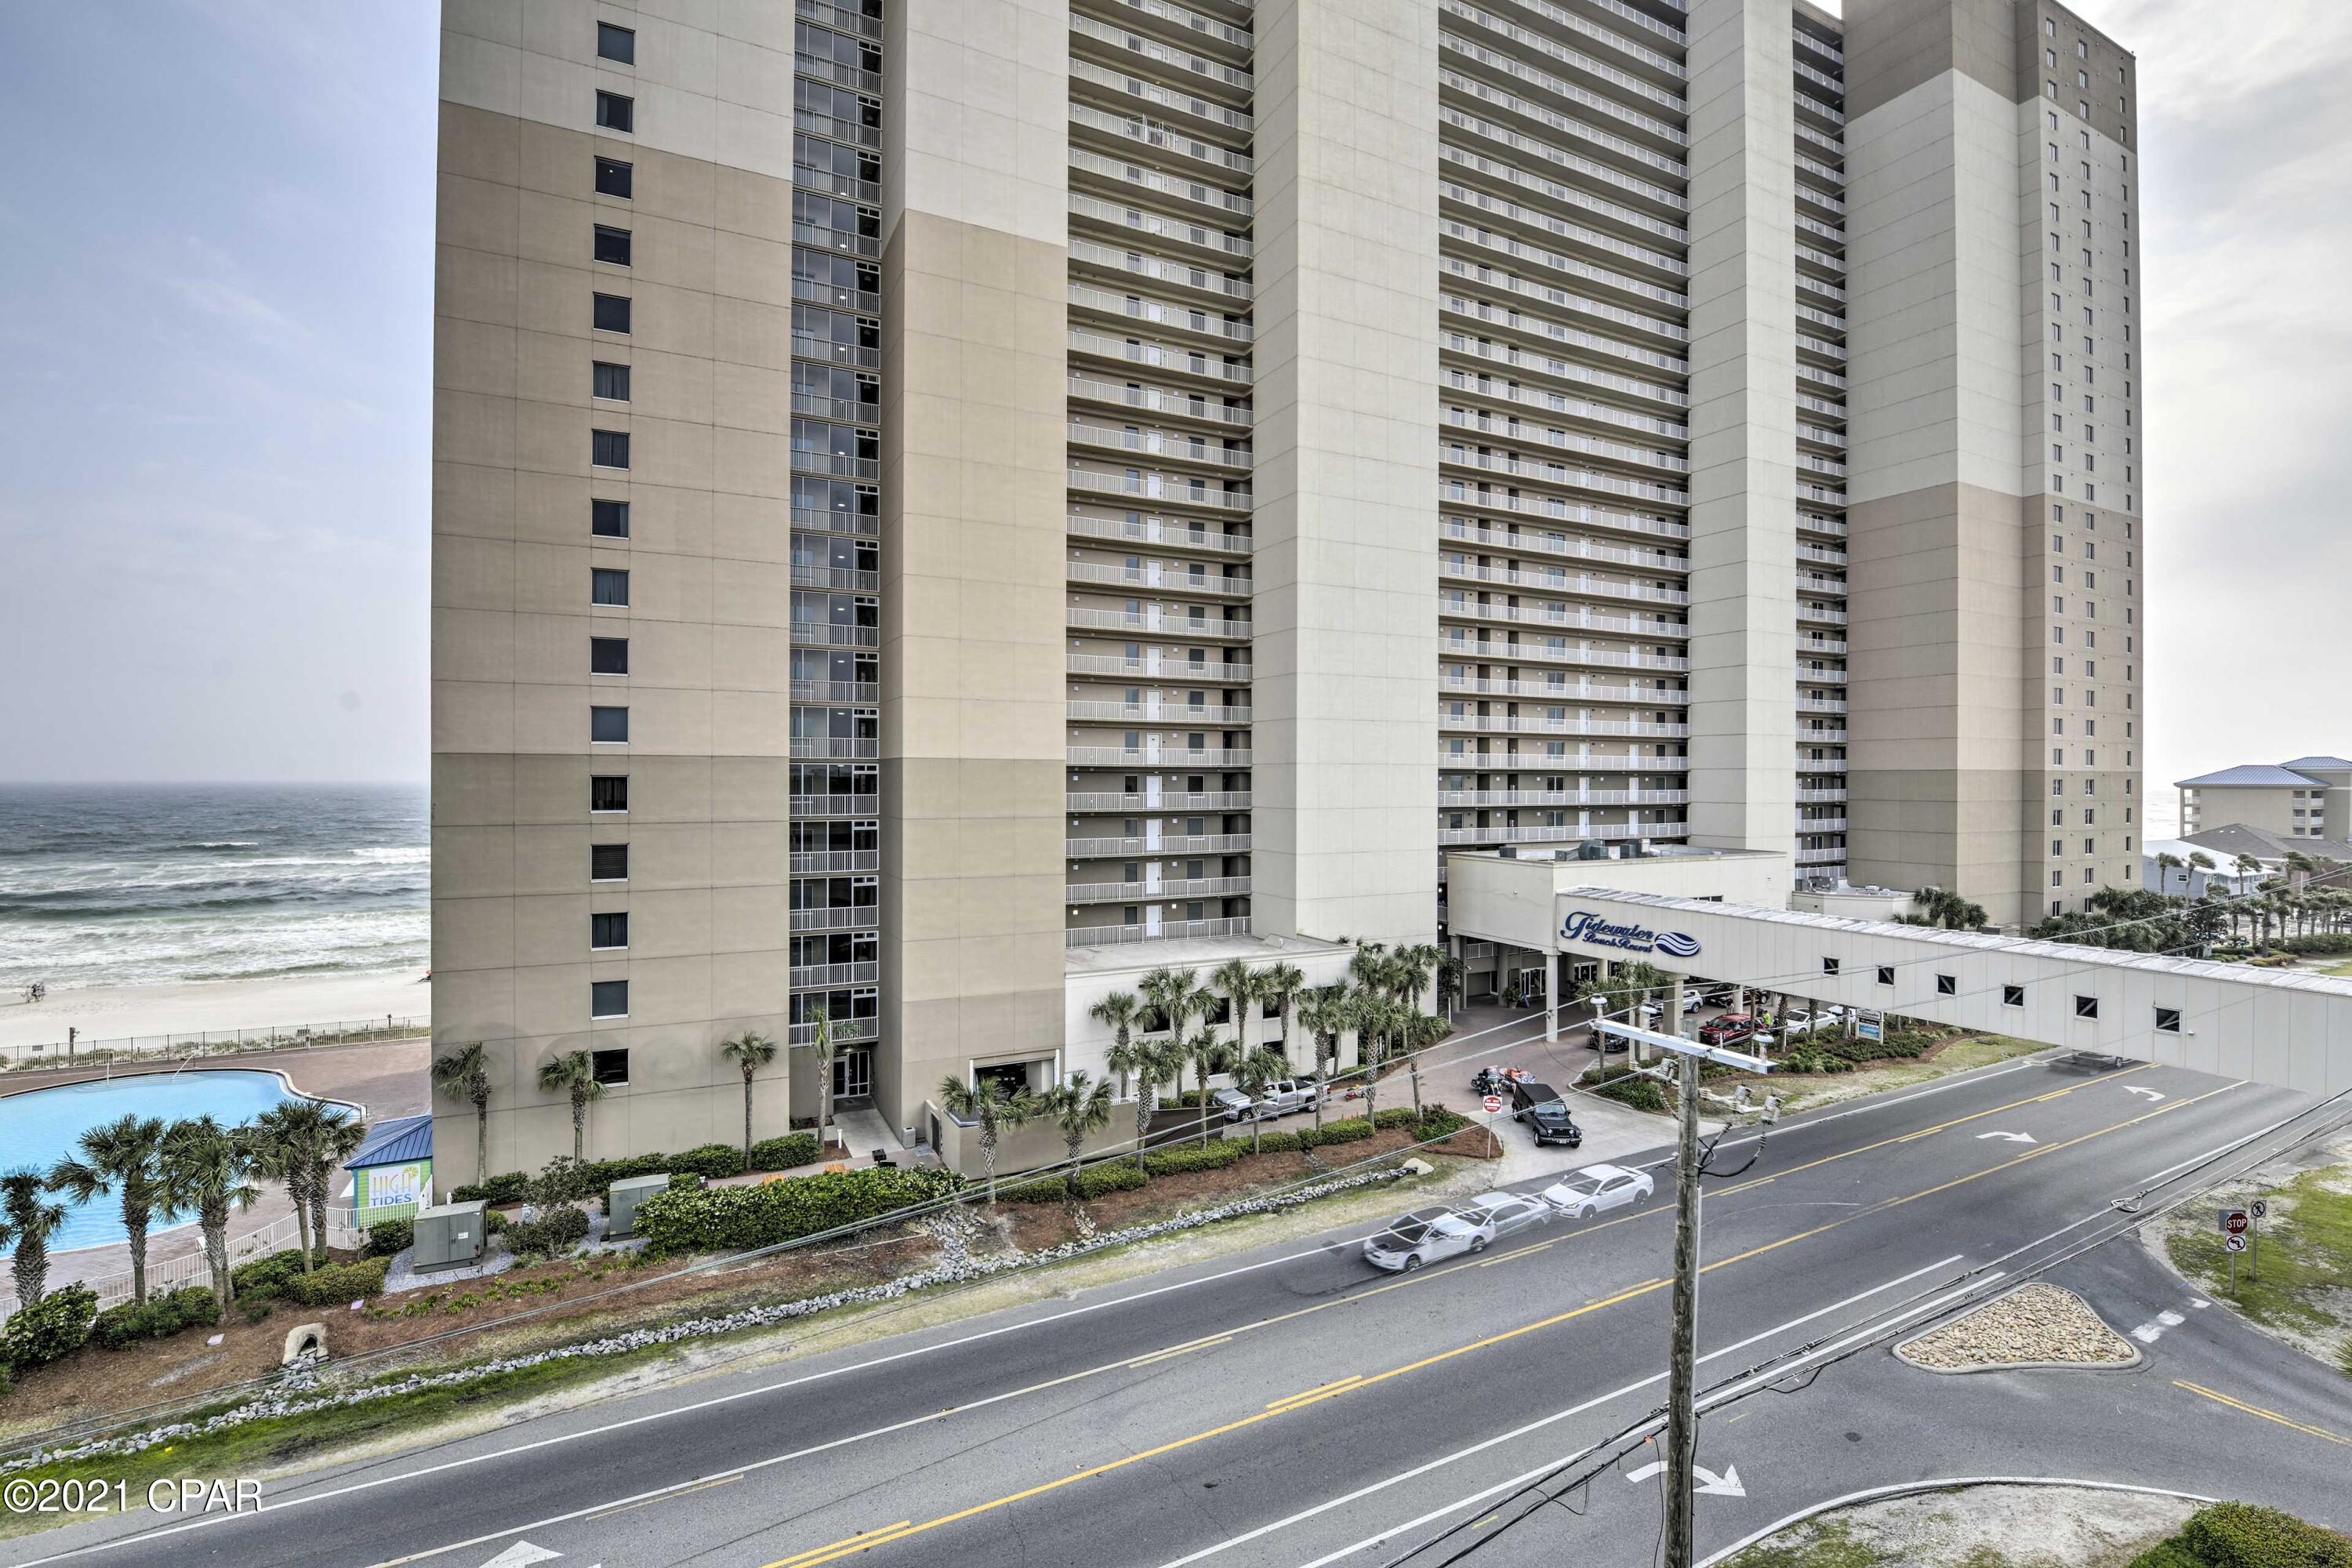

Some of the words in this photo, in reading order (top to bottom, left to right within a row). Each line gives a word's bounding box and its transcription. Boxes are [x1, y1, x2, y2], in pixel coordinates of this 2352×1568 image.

[1560, 911, 1654, 939] Tidewater
[371, 1173, 412, 1196] HIGH
[371, 1193, 412, 1207] TIDES
[2227, 1218, 2247, 1229] STOP
